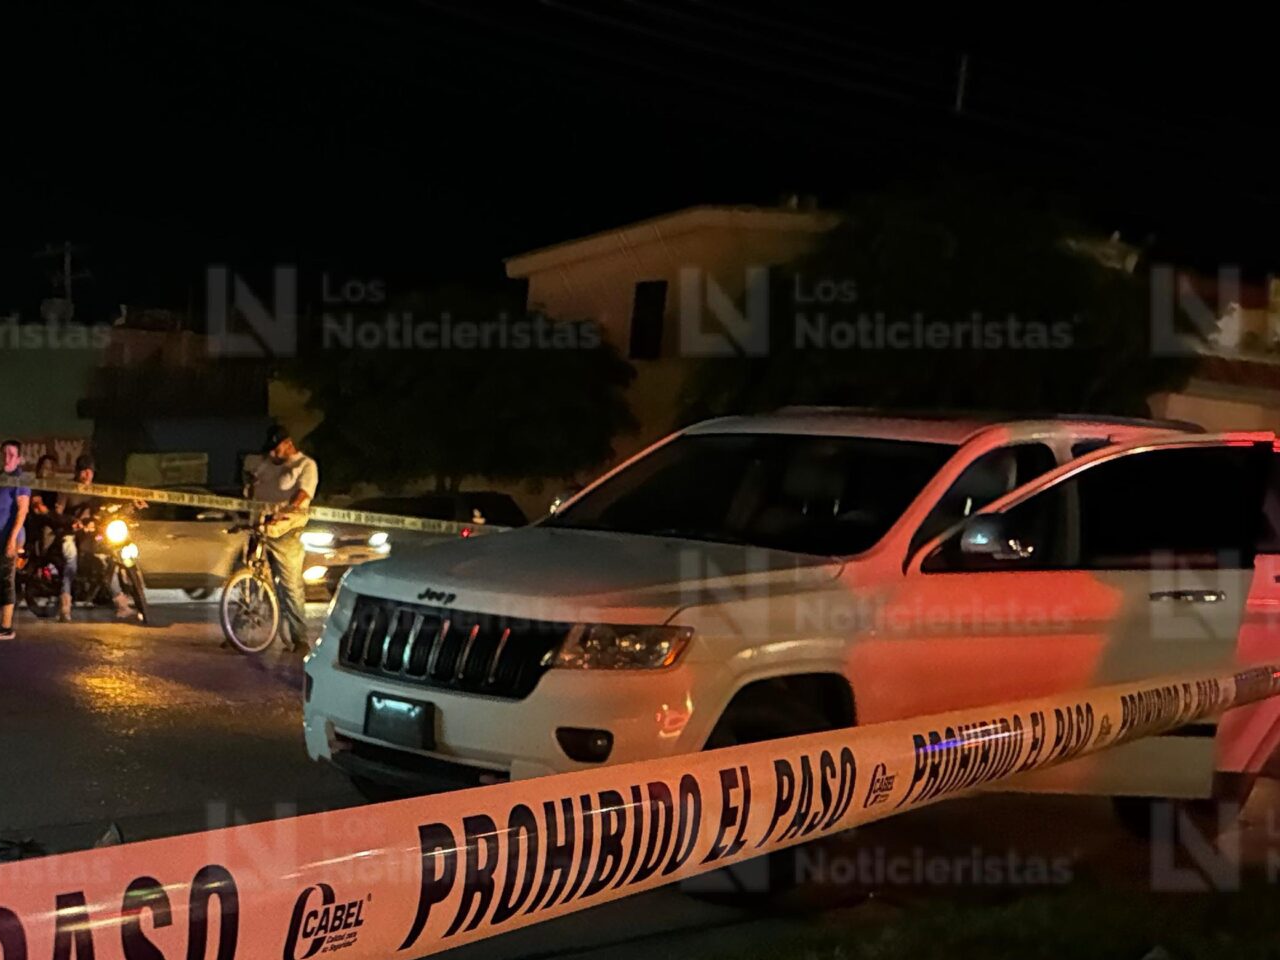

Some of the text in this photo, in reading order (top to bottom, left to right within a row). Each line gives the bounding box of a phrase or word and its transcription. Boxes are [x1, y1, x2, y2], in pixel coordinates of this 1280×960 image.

[418, 588, 456, 604] Jeep
[302, 899, 364, 939] CABEL
[397, 773, 702, 952] PROHIBIDO
[700, 765, 752, 865] EL
[754, 746, 857, 850] PASO
[895, 714, 1024, 809] PROHIBIDO
[1015, 711, 1046, 773] EL
[1040, 702, 1094, 766] PASO
